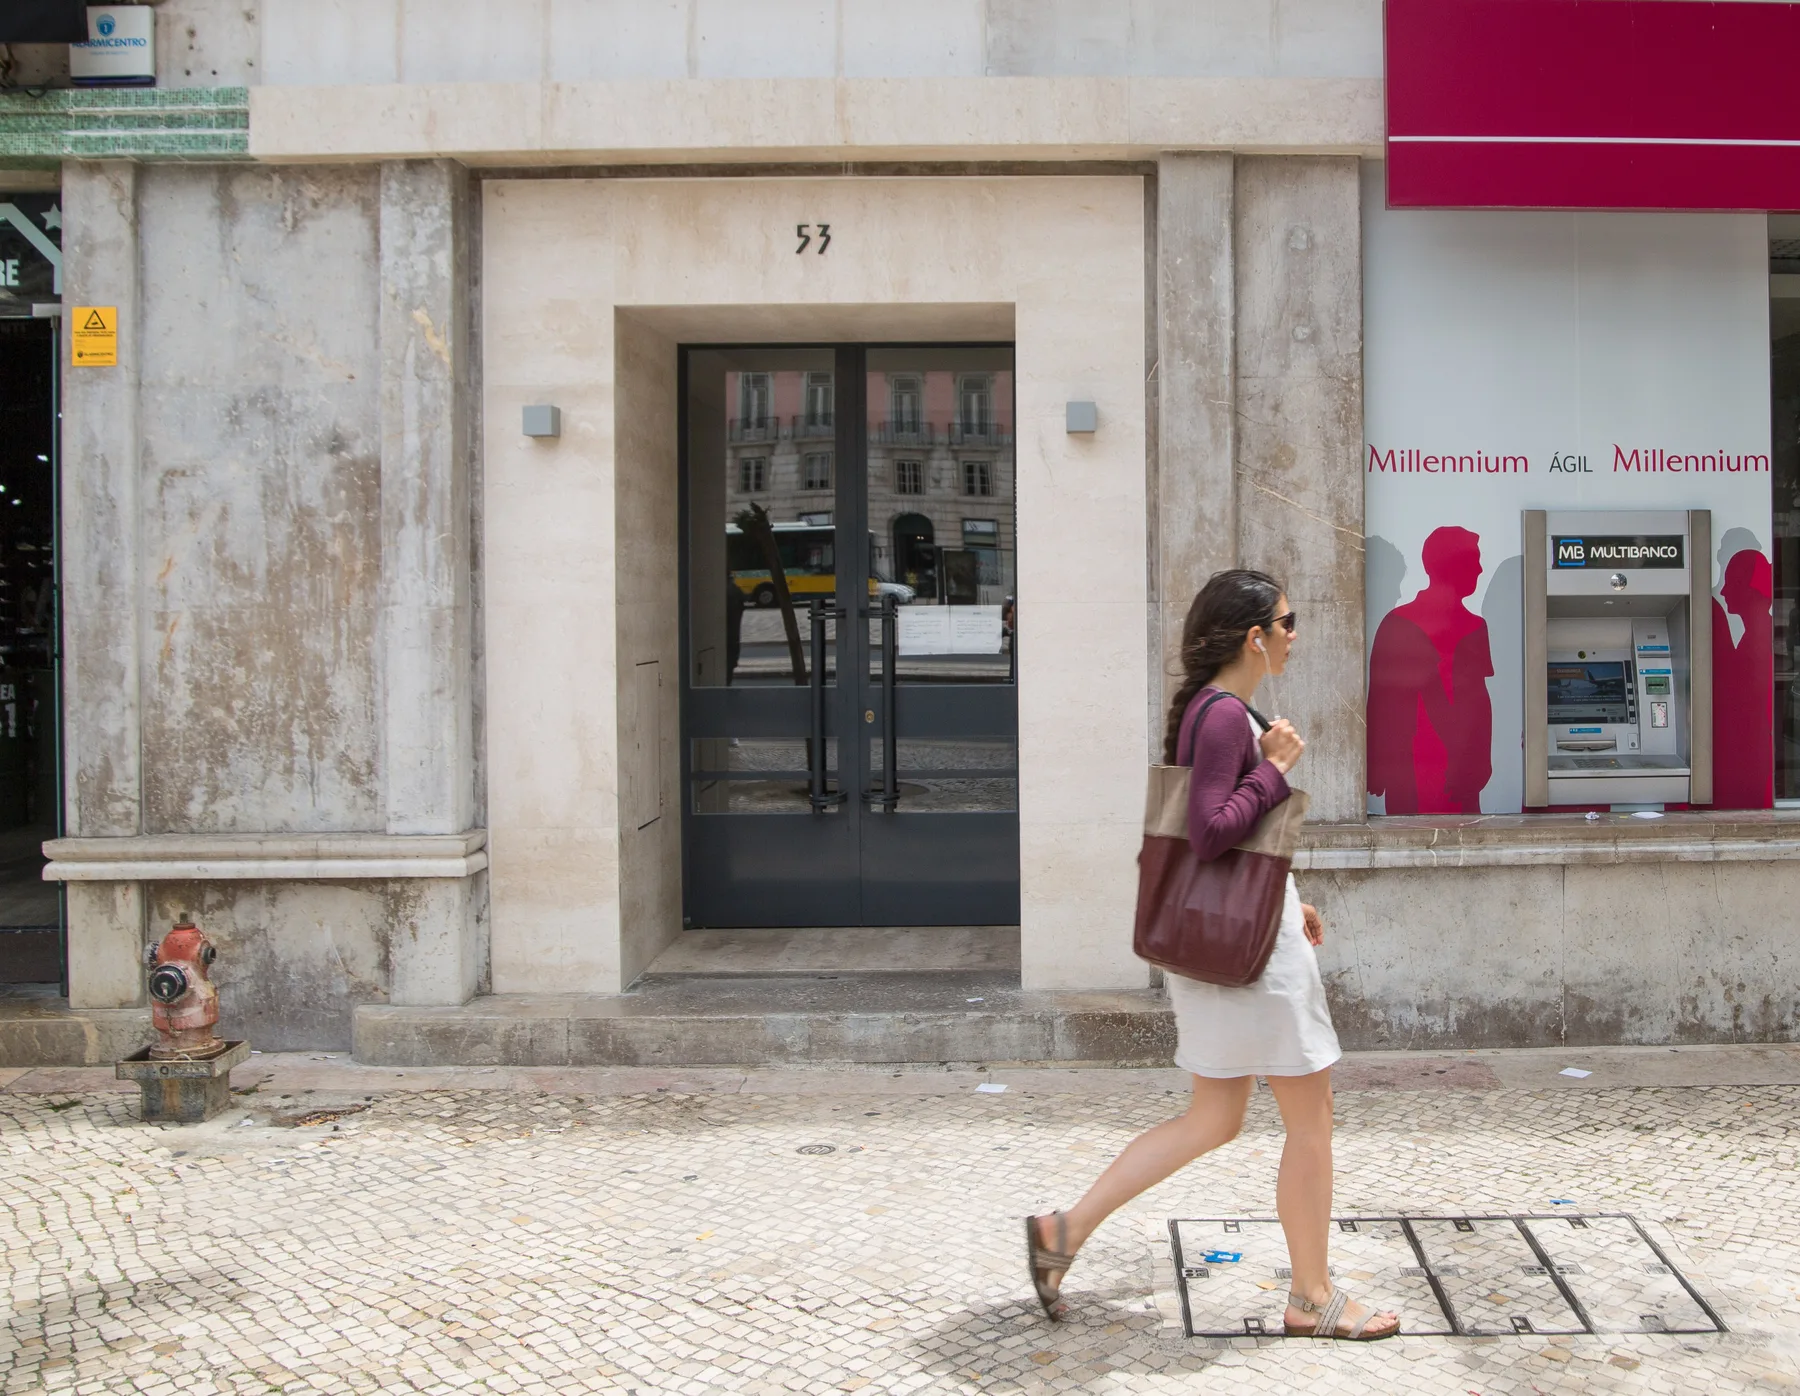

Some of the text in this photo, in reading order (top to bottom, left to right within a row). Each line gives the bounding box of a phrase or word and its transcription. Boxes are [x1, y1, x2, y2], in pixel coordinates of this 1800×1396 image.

[796, 224, 831, 254] 53
[1367, 443, 1769, 473] Millennium ÁGIL Millennium
[1558, 545, 1678, 560] MB MULTIBANCO
